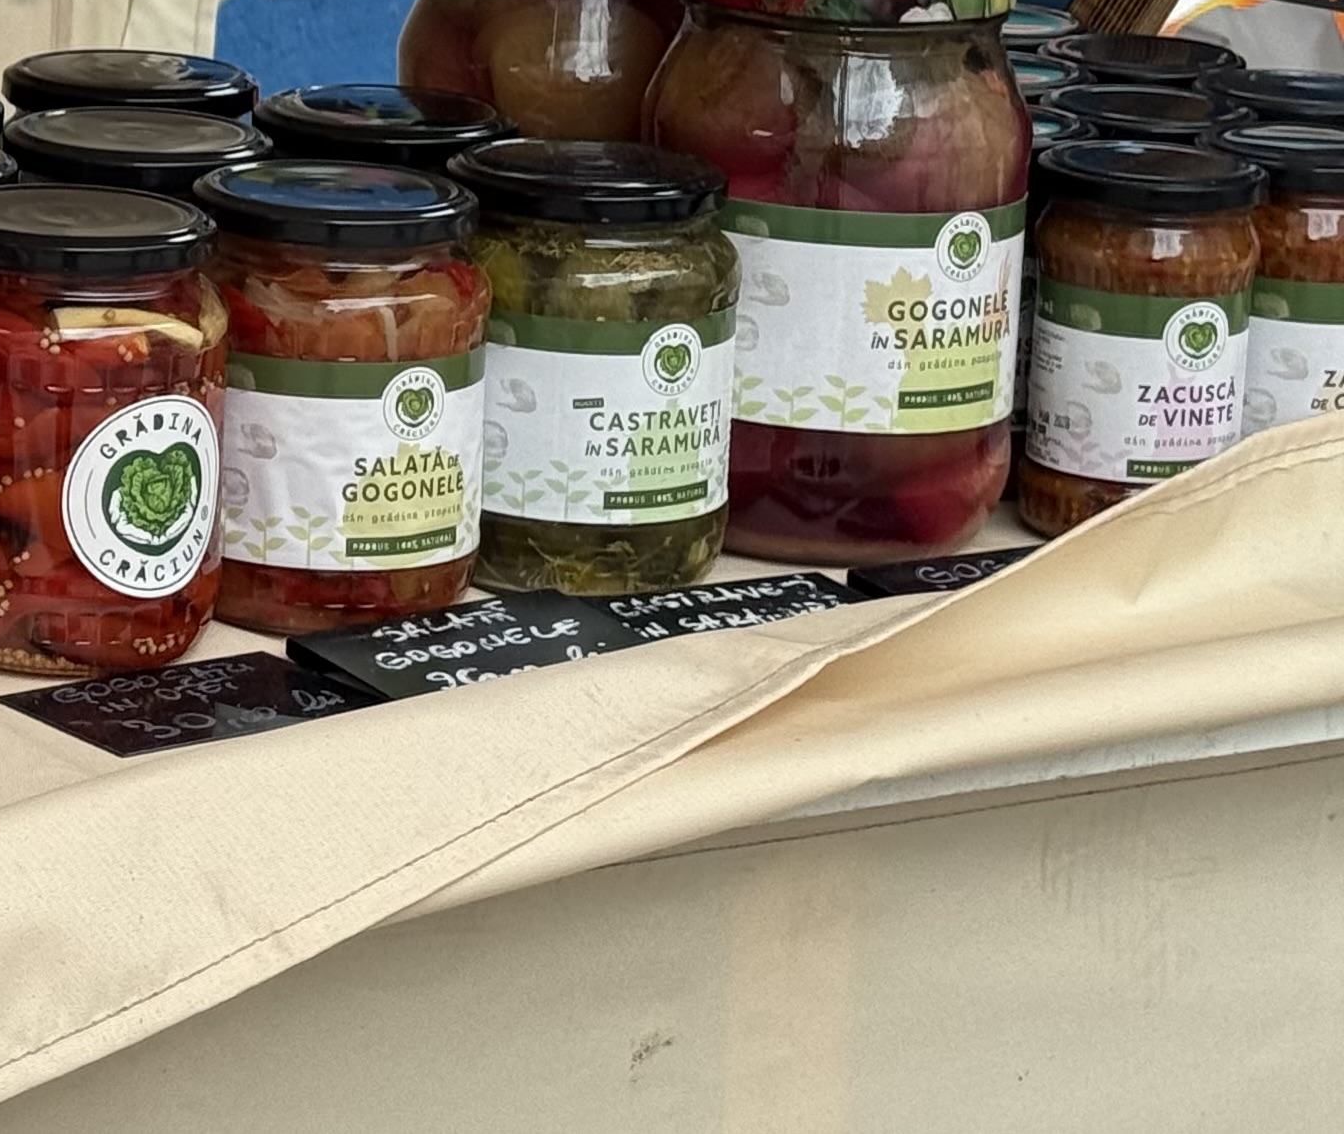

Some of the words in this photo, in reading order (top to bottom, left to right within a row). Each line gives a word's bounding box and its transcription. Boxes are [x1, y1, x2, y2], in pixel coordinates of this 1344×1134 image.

[887, 289, 1008, 322] GOGONELE
[870, 331, 890, 350] ÎN
[893, 314, 1011, 350] SARAMURĂ
[887, 359, 912, 371] din
[1137, 376, 1236, 405] ZACUSCĂ
[1310, 398, 1330, 411] DE
[588, 398, 722, 432] CASTRAVEȚI
[1138, 414, 1156, 427] DE
[1163, 403, 1234, 427] VINETE
[98, 412, 202, 460] GRĂDINA
[584, 442, 602, 458] ÎN
[604, 423, 721, 458] SARAMURĂ
[1123, 436, 1146, 447] din
[353, 445, 444, 478] SALATĂ
[446, 452, 460, 470] DE
[341, 470, 464, 504] GOGONELE
[98, 527, 204, 584] CRĂCIUN
